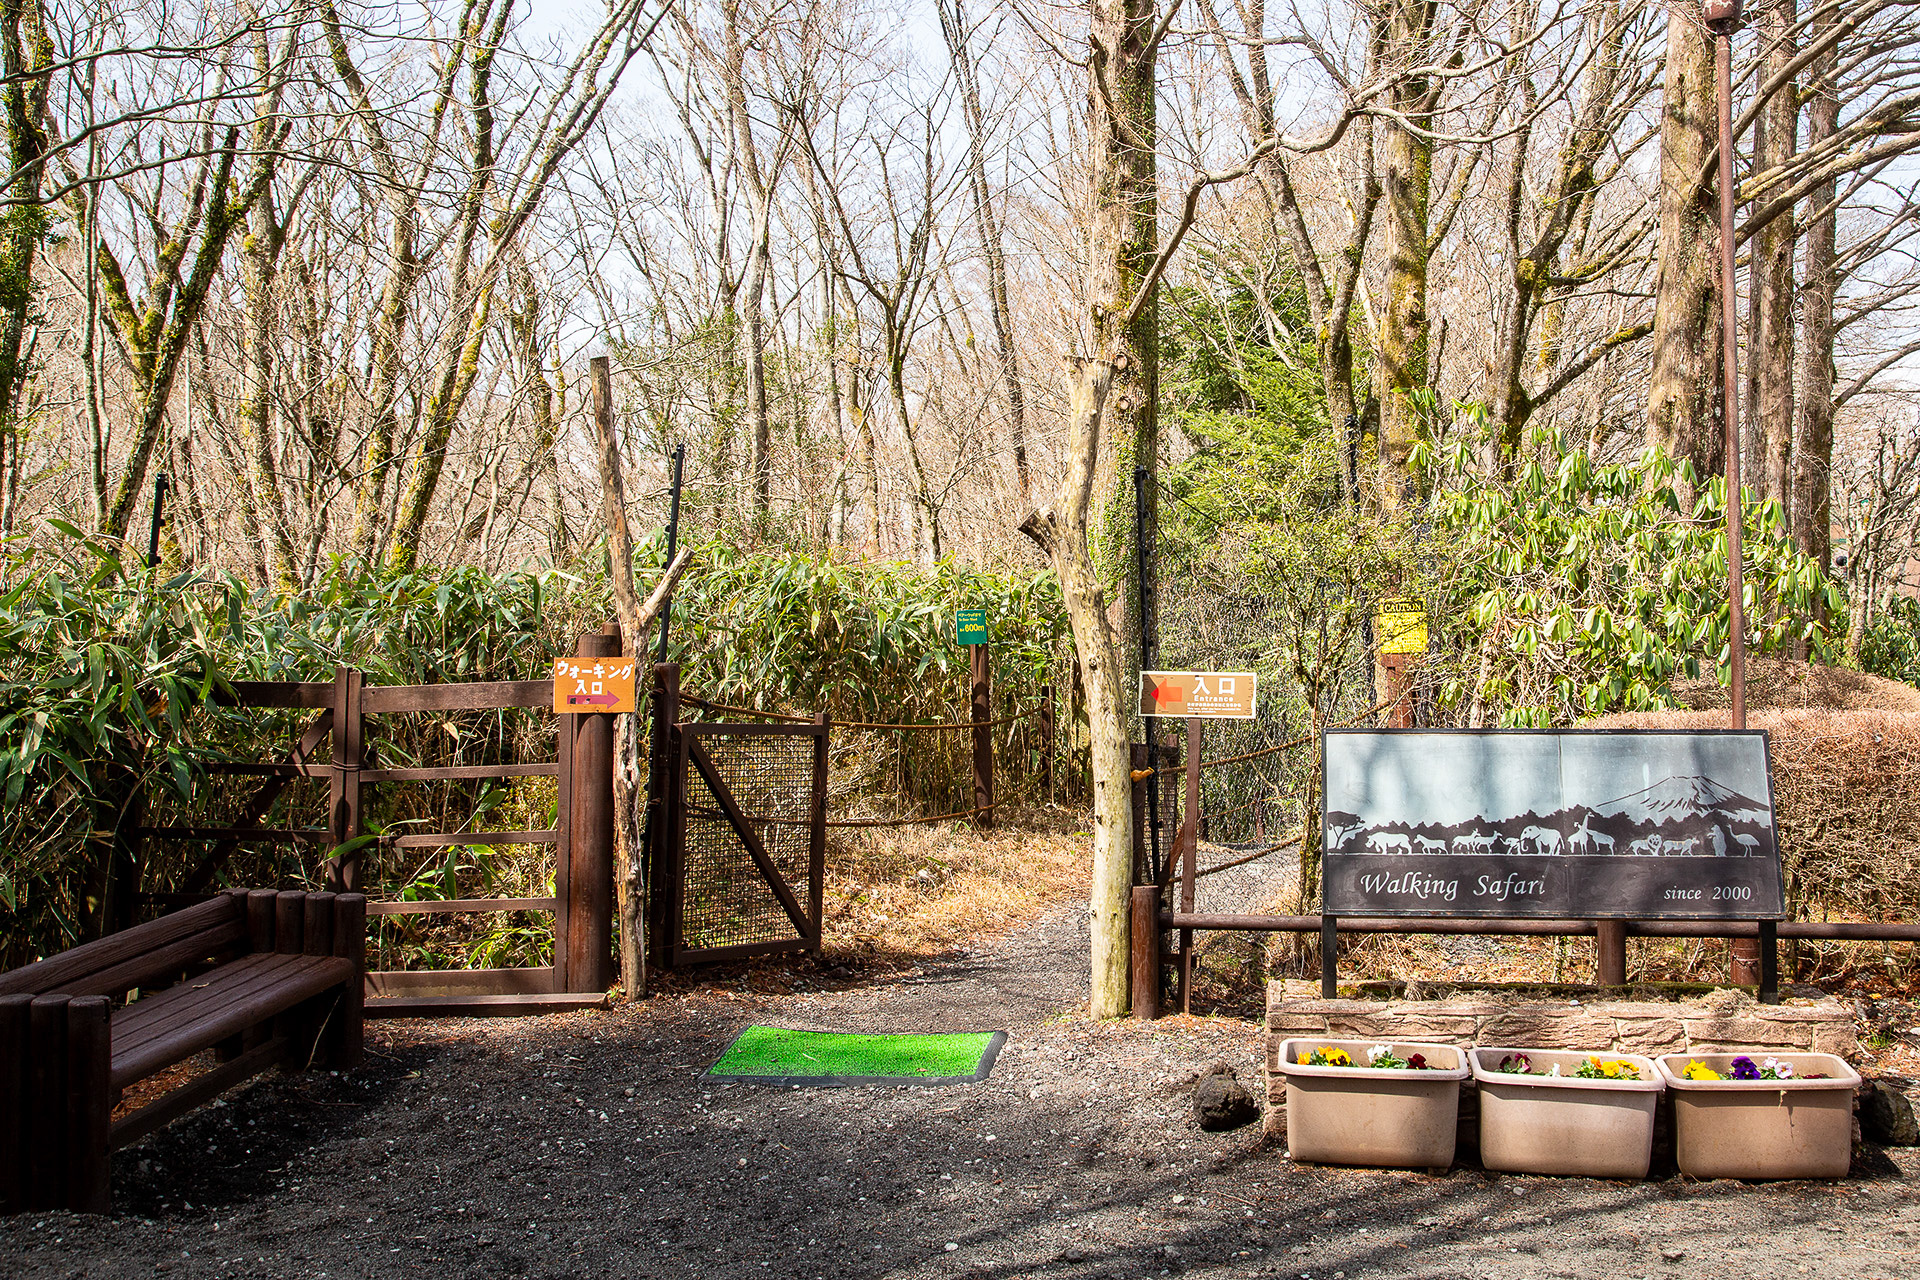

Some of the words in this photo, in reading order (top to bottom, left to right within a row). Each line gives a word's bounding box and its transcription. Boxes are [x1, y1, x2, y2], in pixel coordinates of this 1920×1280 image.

[557, 660, 634, 680] ウォーキング
[575, 679, 602, 695] 入口
[1192, 677, 1235, 695] 入口
[1194, 694, 1234, 702] Entrance
[1360, 871, 1459, 901] Walking
[1473, 872, 1545, 901] Safari
[1664, 885, 1702, 900] since
[1712, 886, 1751, 900] 2000
